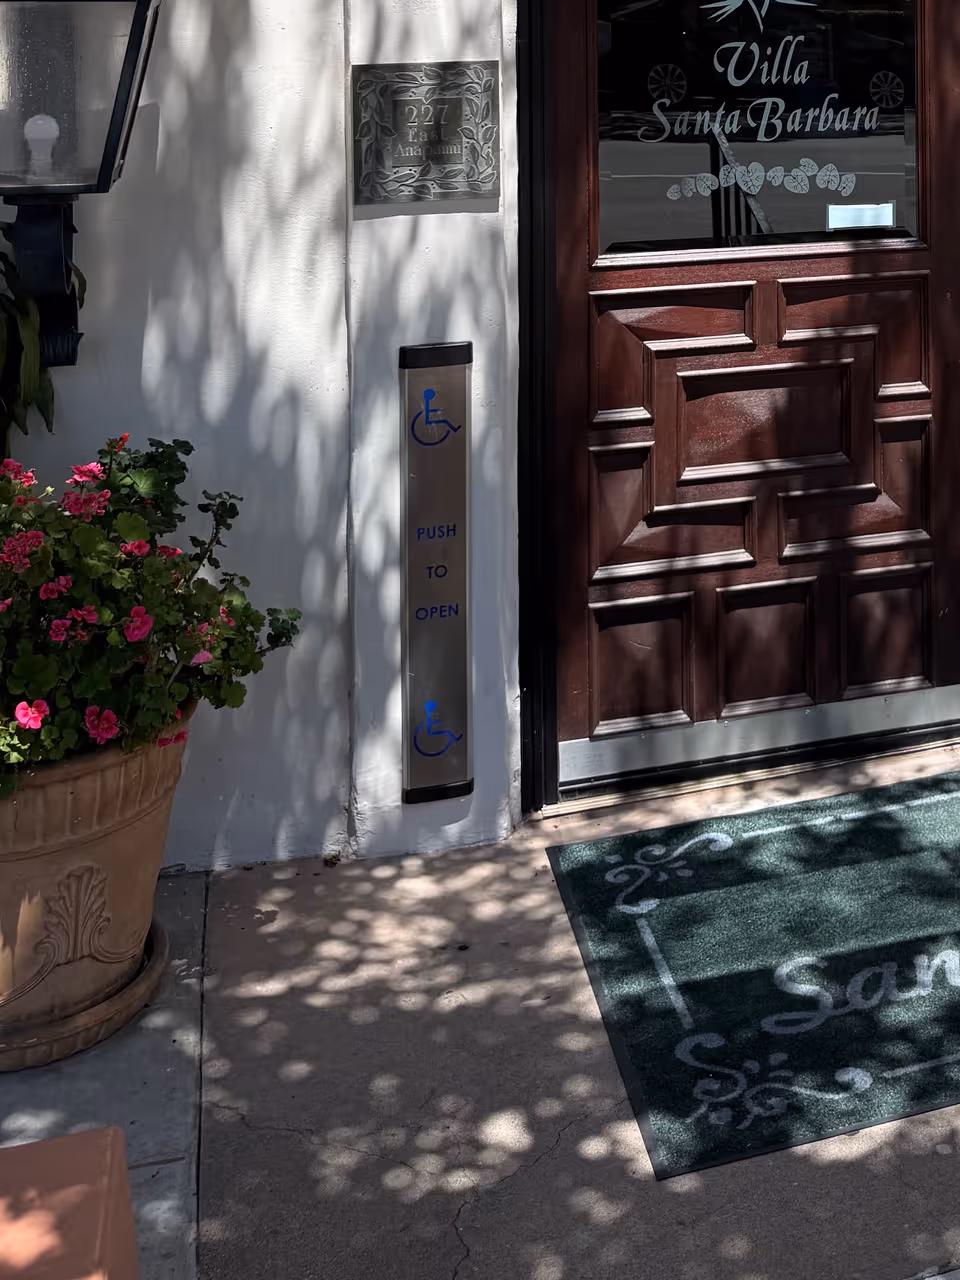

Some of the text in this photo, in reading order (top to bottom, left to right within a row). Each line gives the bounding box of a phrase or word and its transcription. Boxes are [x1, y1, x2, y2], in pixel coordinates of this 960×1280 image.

[713, 35, 811, 87] Villa
[405, 104, 449, 126] 227
[637, 93, 880, 143] Santa Barbara
[408, 126, 448, 143] East
[416, 523, 457, 541] PUSH
[426, 564, 448, 579] TO
[415, 602, 460, 621] OPEN
